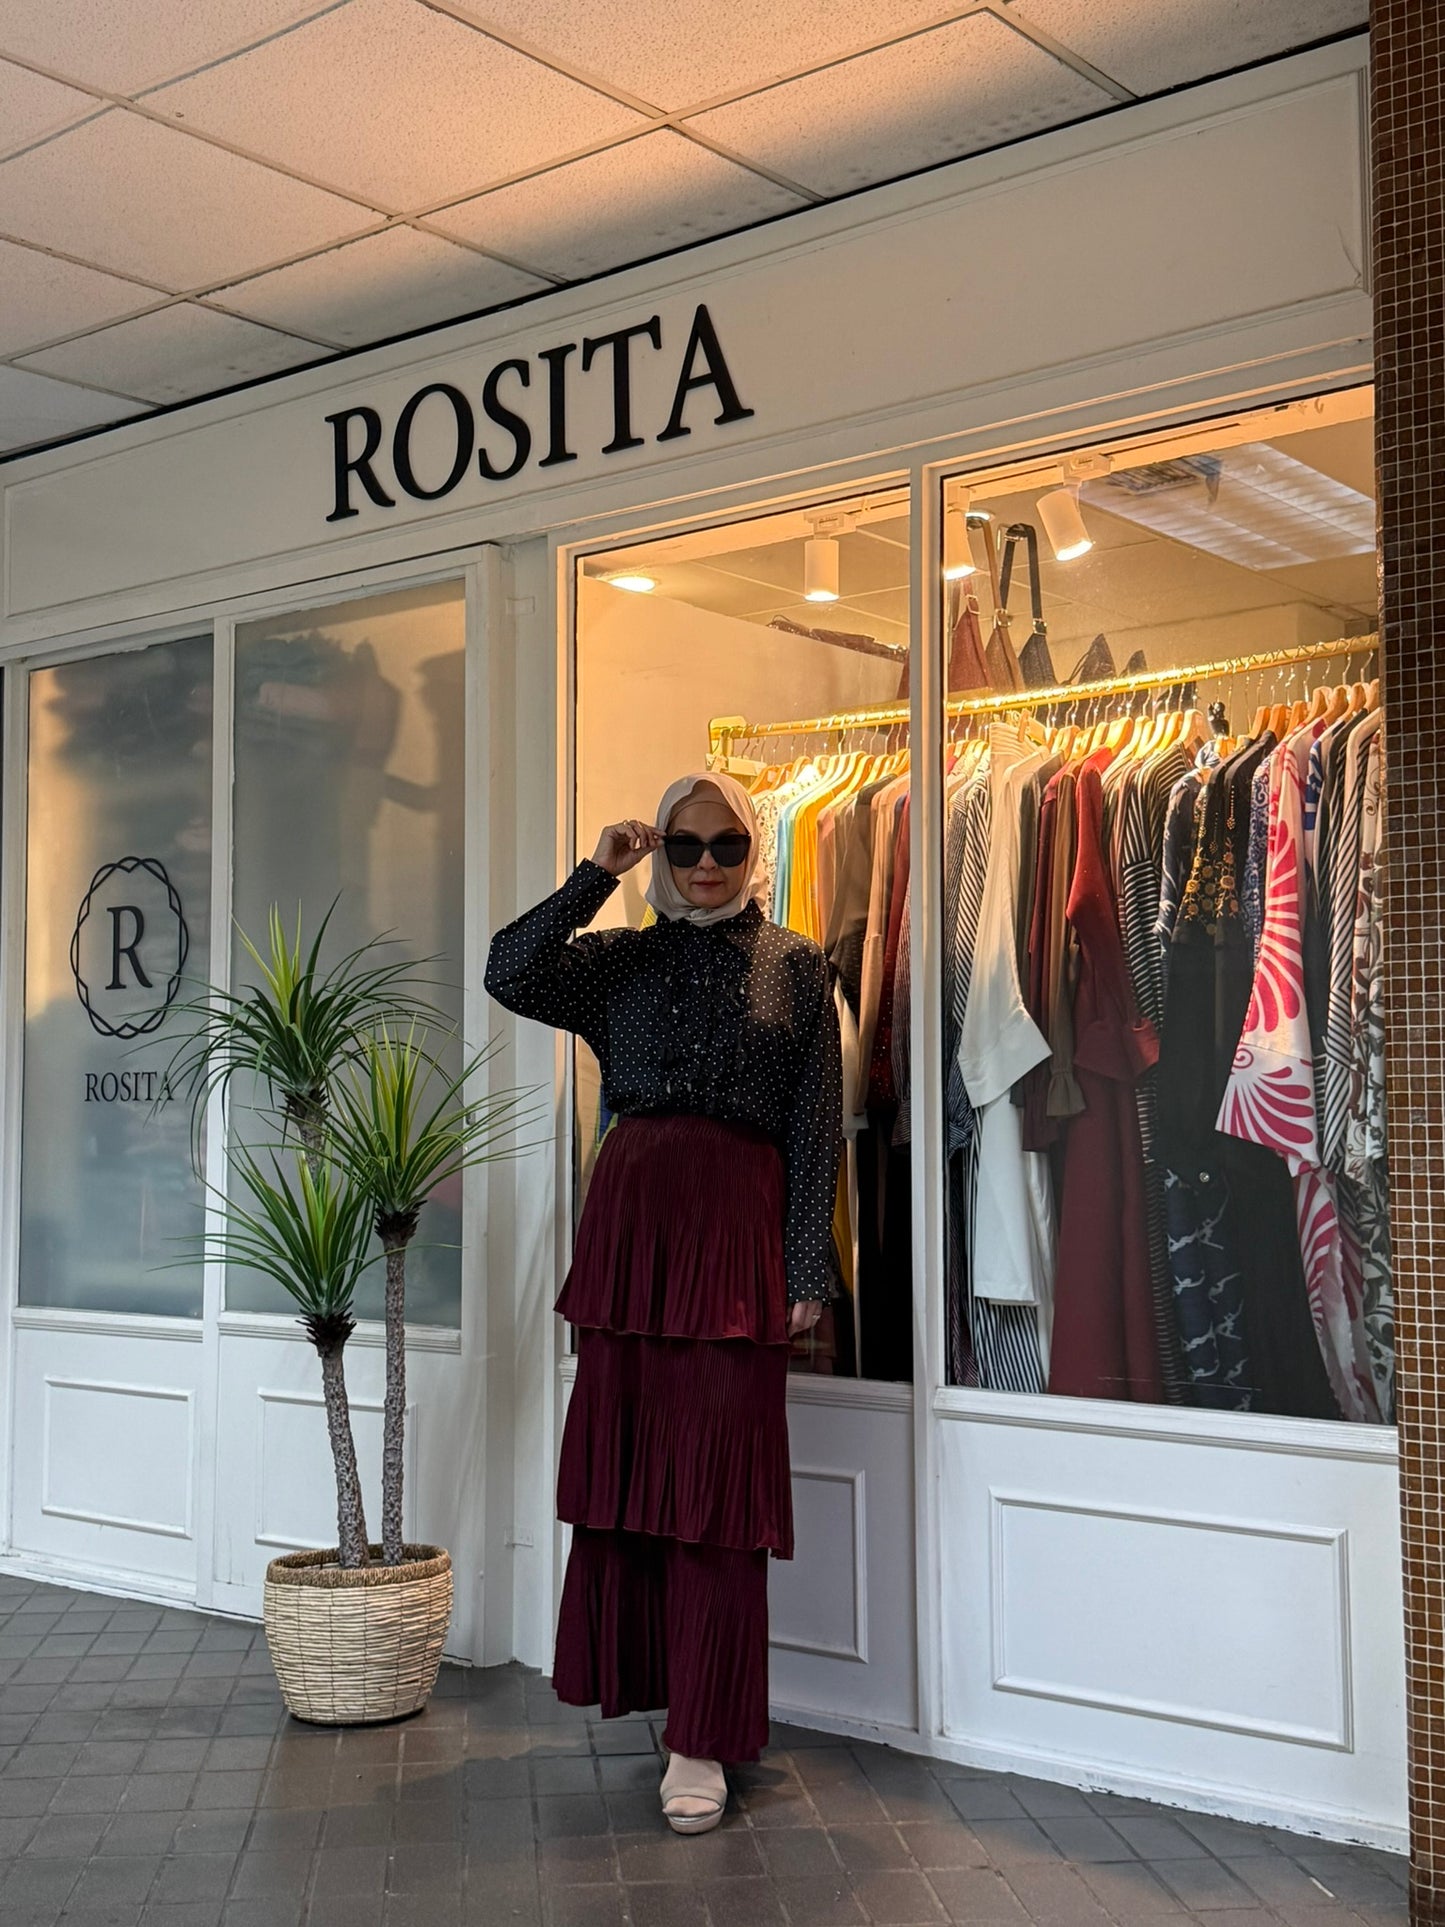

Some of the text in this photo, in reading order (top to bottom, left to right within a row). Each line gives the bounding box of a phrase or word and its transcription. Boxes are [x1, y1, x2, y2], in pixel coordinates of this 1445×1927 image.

[324, 303, 755, 522] ROSITA
[105, 905, 153, 990] R
[84, 1071, 174, 1102] ROSITA
